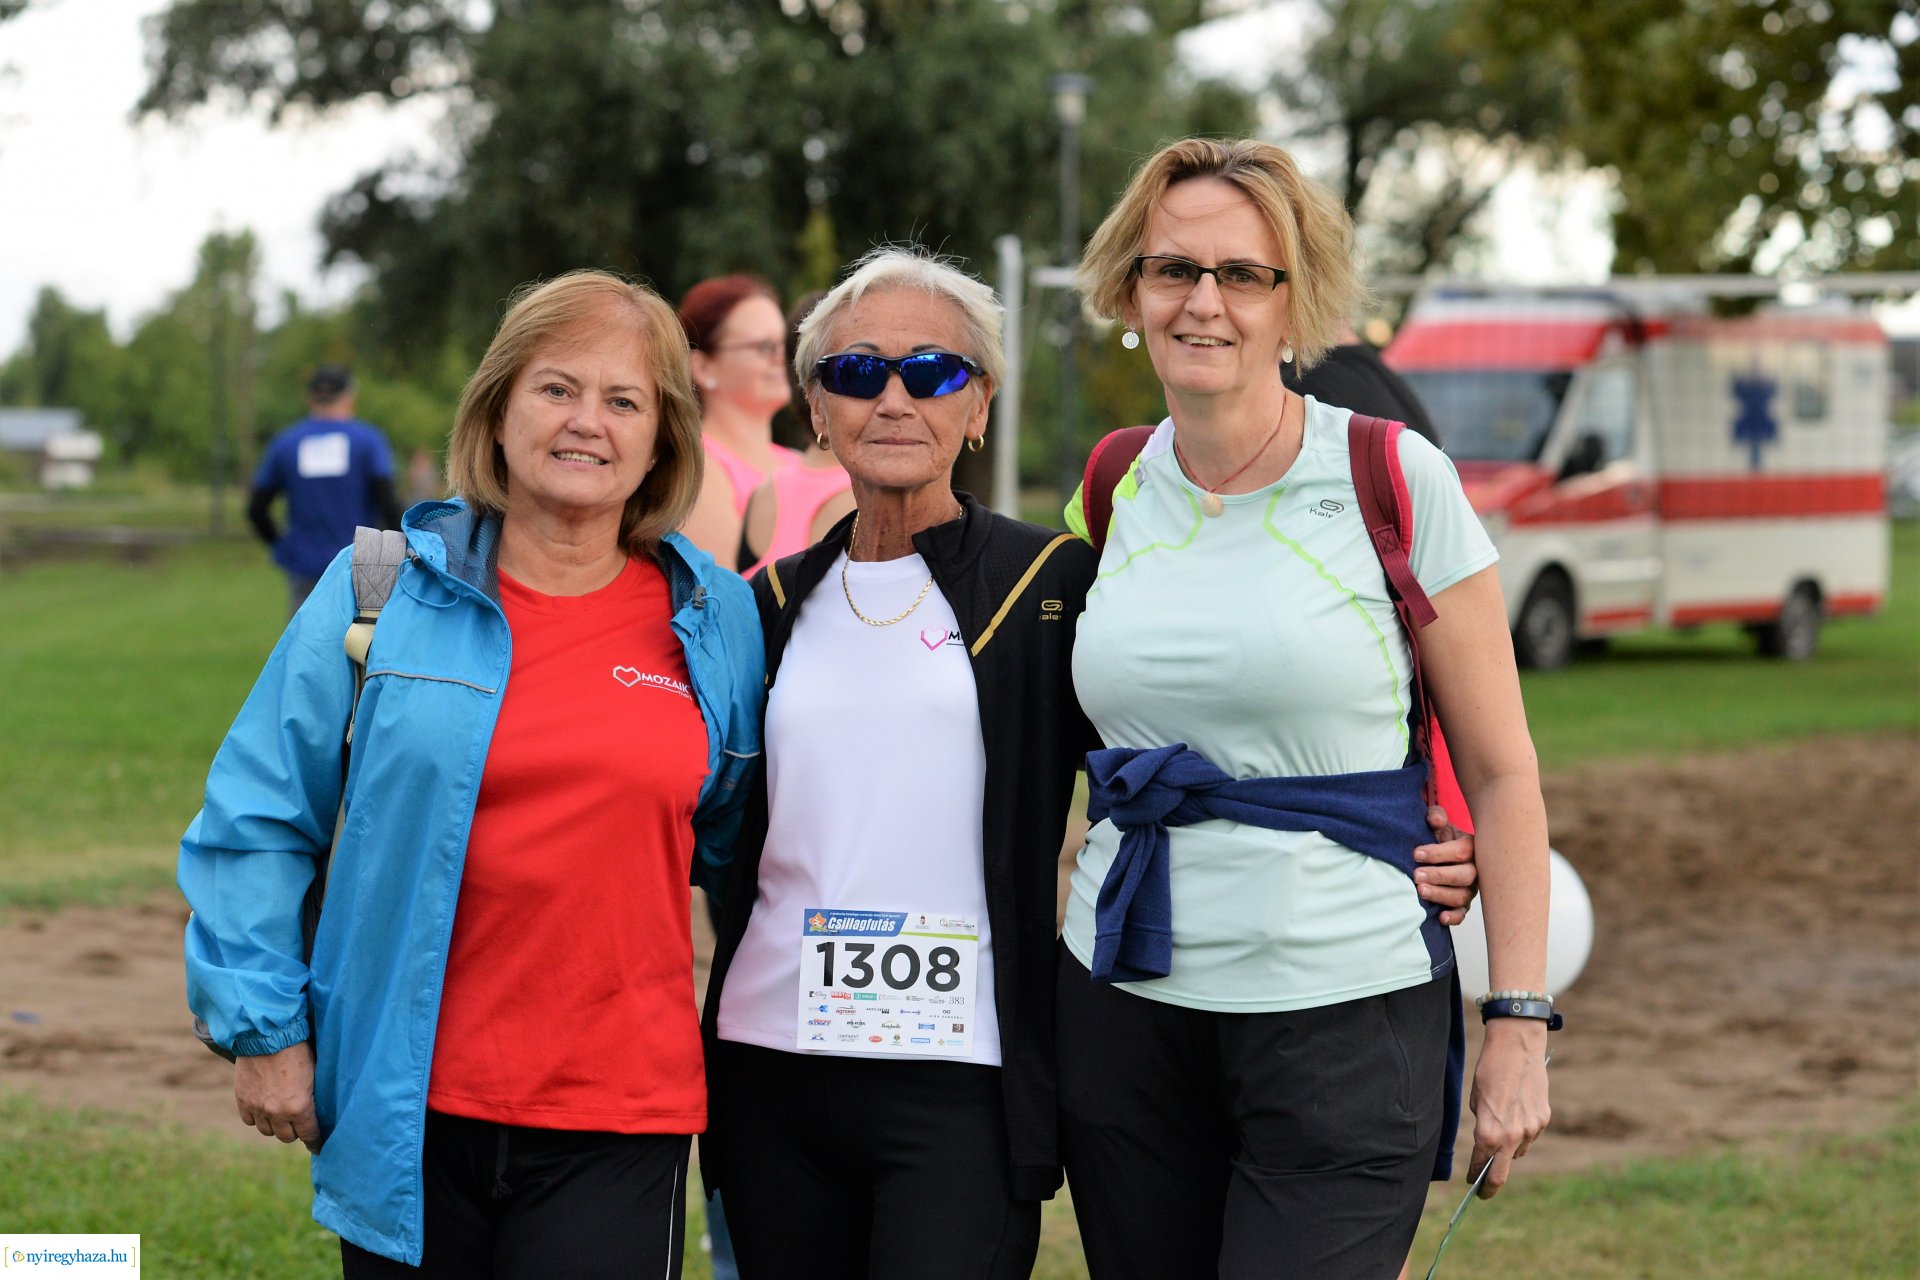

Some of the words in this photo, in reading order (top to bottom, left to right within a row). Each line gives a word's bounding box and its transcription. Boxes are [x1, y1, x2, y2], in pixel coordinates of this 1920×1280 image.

[641, 672, 689, 694] MOZAIK
[827, 916, 896, 932] Csillagfutás
[816, 941, 961, 992] 1308
[948, 996, 965, 1005] 383
